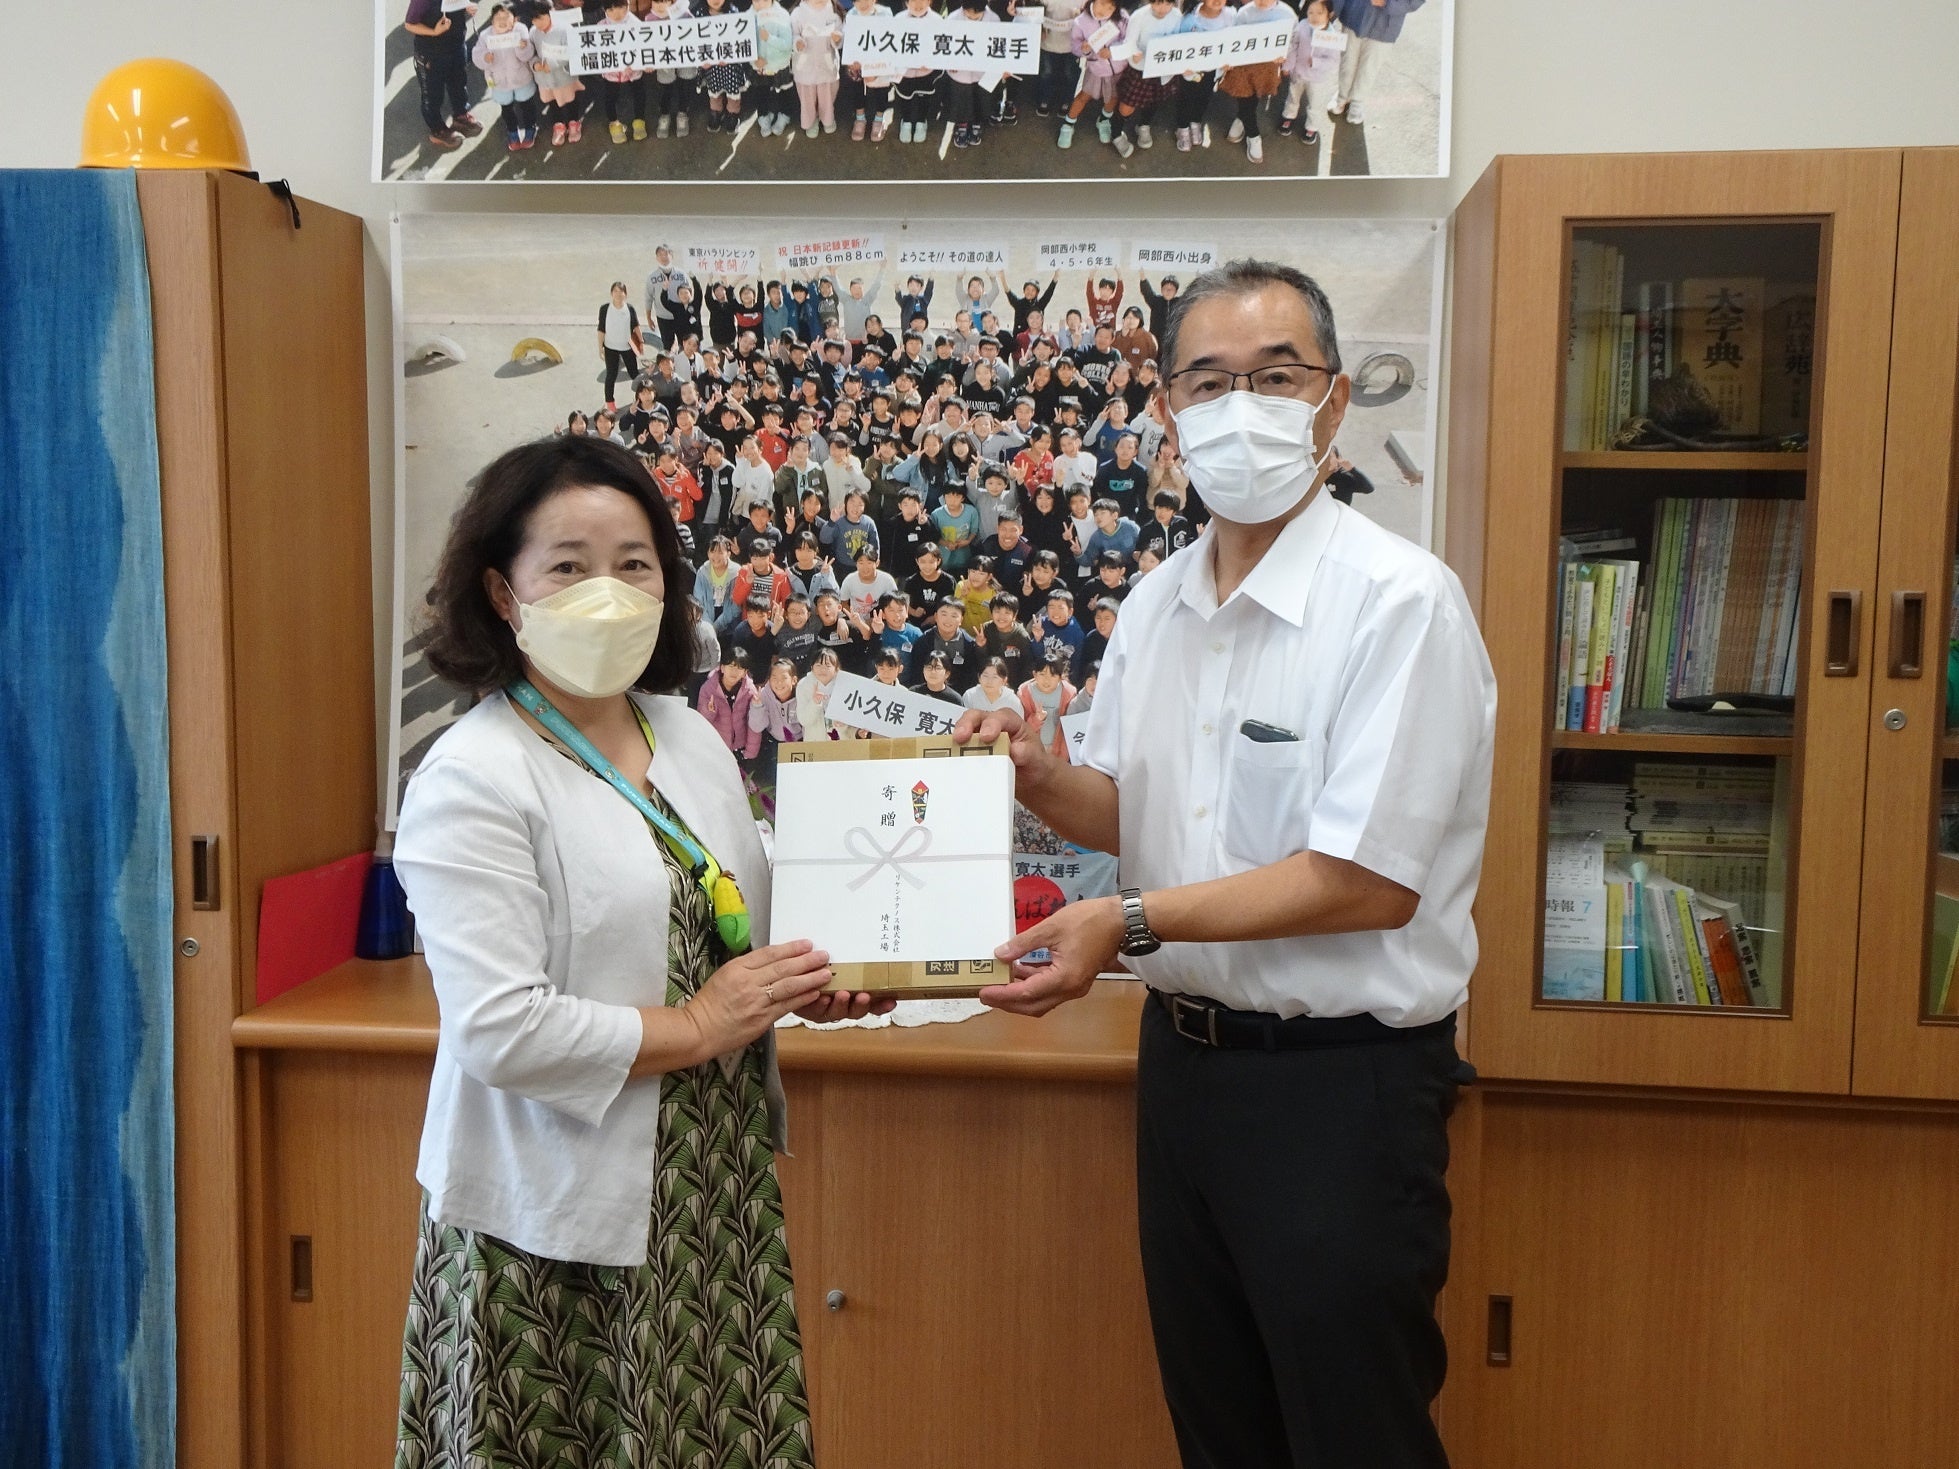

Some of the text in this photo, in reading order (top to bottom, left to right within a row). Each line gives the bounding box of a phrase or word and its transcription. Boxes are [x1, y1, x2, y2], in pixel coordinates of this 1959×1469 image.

[579, 18, 749, 48] 東京パラリンピック
[857, 30, 1029, 60] 小久保 寛太 選手
[580, 40, 752, 71] 幅跳び日本代表候補
[1153, 34, 1289, 64] 令和2年12月1日
[949, 250, 1004, 263] その道の達人
[1041, 243, 1097, 255] 岡部西小学校
[1138, 249, 1212, 264] 岡部西小出身
[844, 690, 906, 725] 小久保
[880, 784, 897, 827] 寄贈
[1050, 863, 1081, 878] 選手
